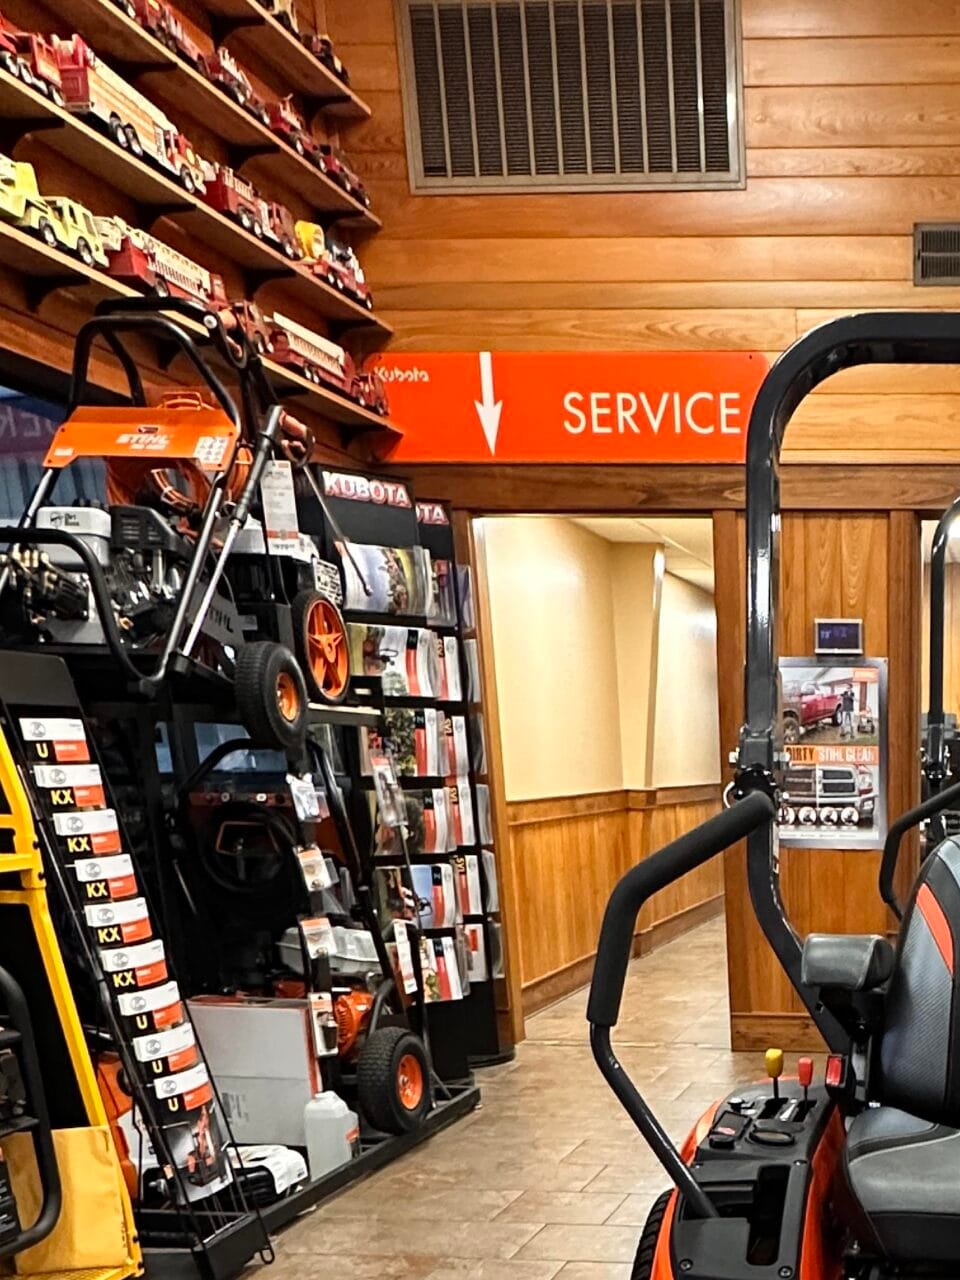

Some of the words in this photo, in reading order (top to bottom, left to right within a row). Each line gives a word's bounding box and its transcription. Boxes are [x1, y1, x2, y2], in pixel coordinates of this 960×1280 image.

[375, 366, 430, 383] Kubota
[563, 391, 741, 435] SERVICE
[322, 471, 412, 508] KUBOTA
[36, 743, 49, 758] U
[785, 746, 816, 763] DIRTY
[51, 789, 74, 805] KX
[67, 836, 91, 853] KX
[86, 882, 108, 899] KX
[98, 926, 121, 943] KX
[113, 971, 135, 987] KX
[136, 1015, 148, 1030] U
[152, 1060, 163, 1074] U
[168, 1098, 179, 1112] U
